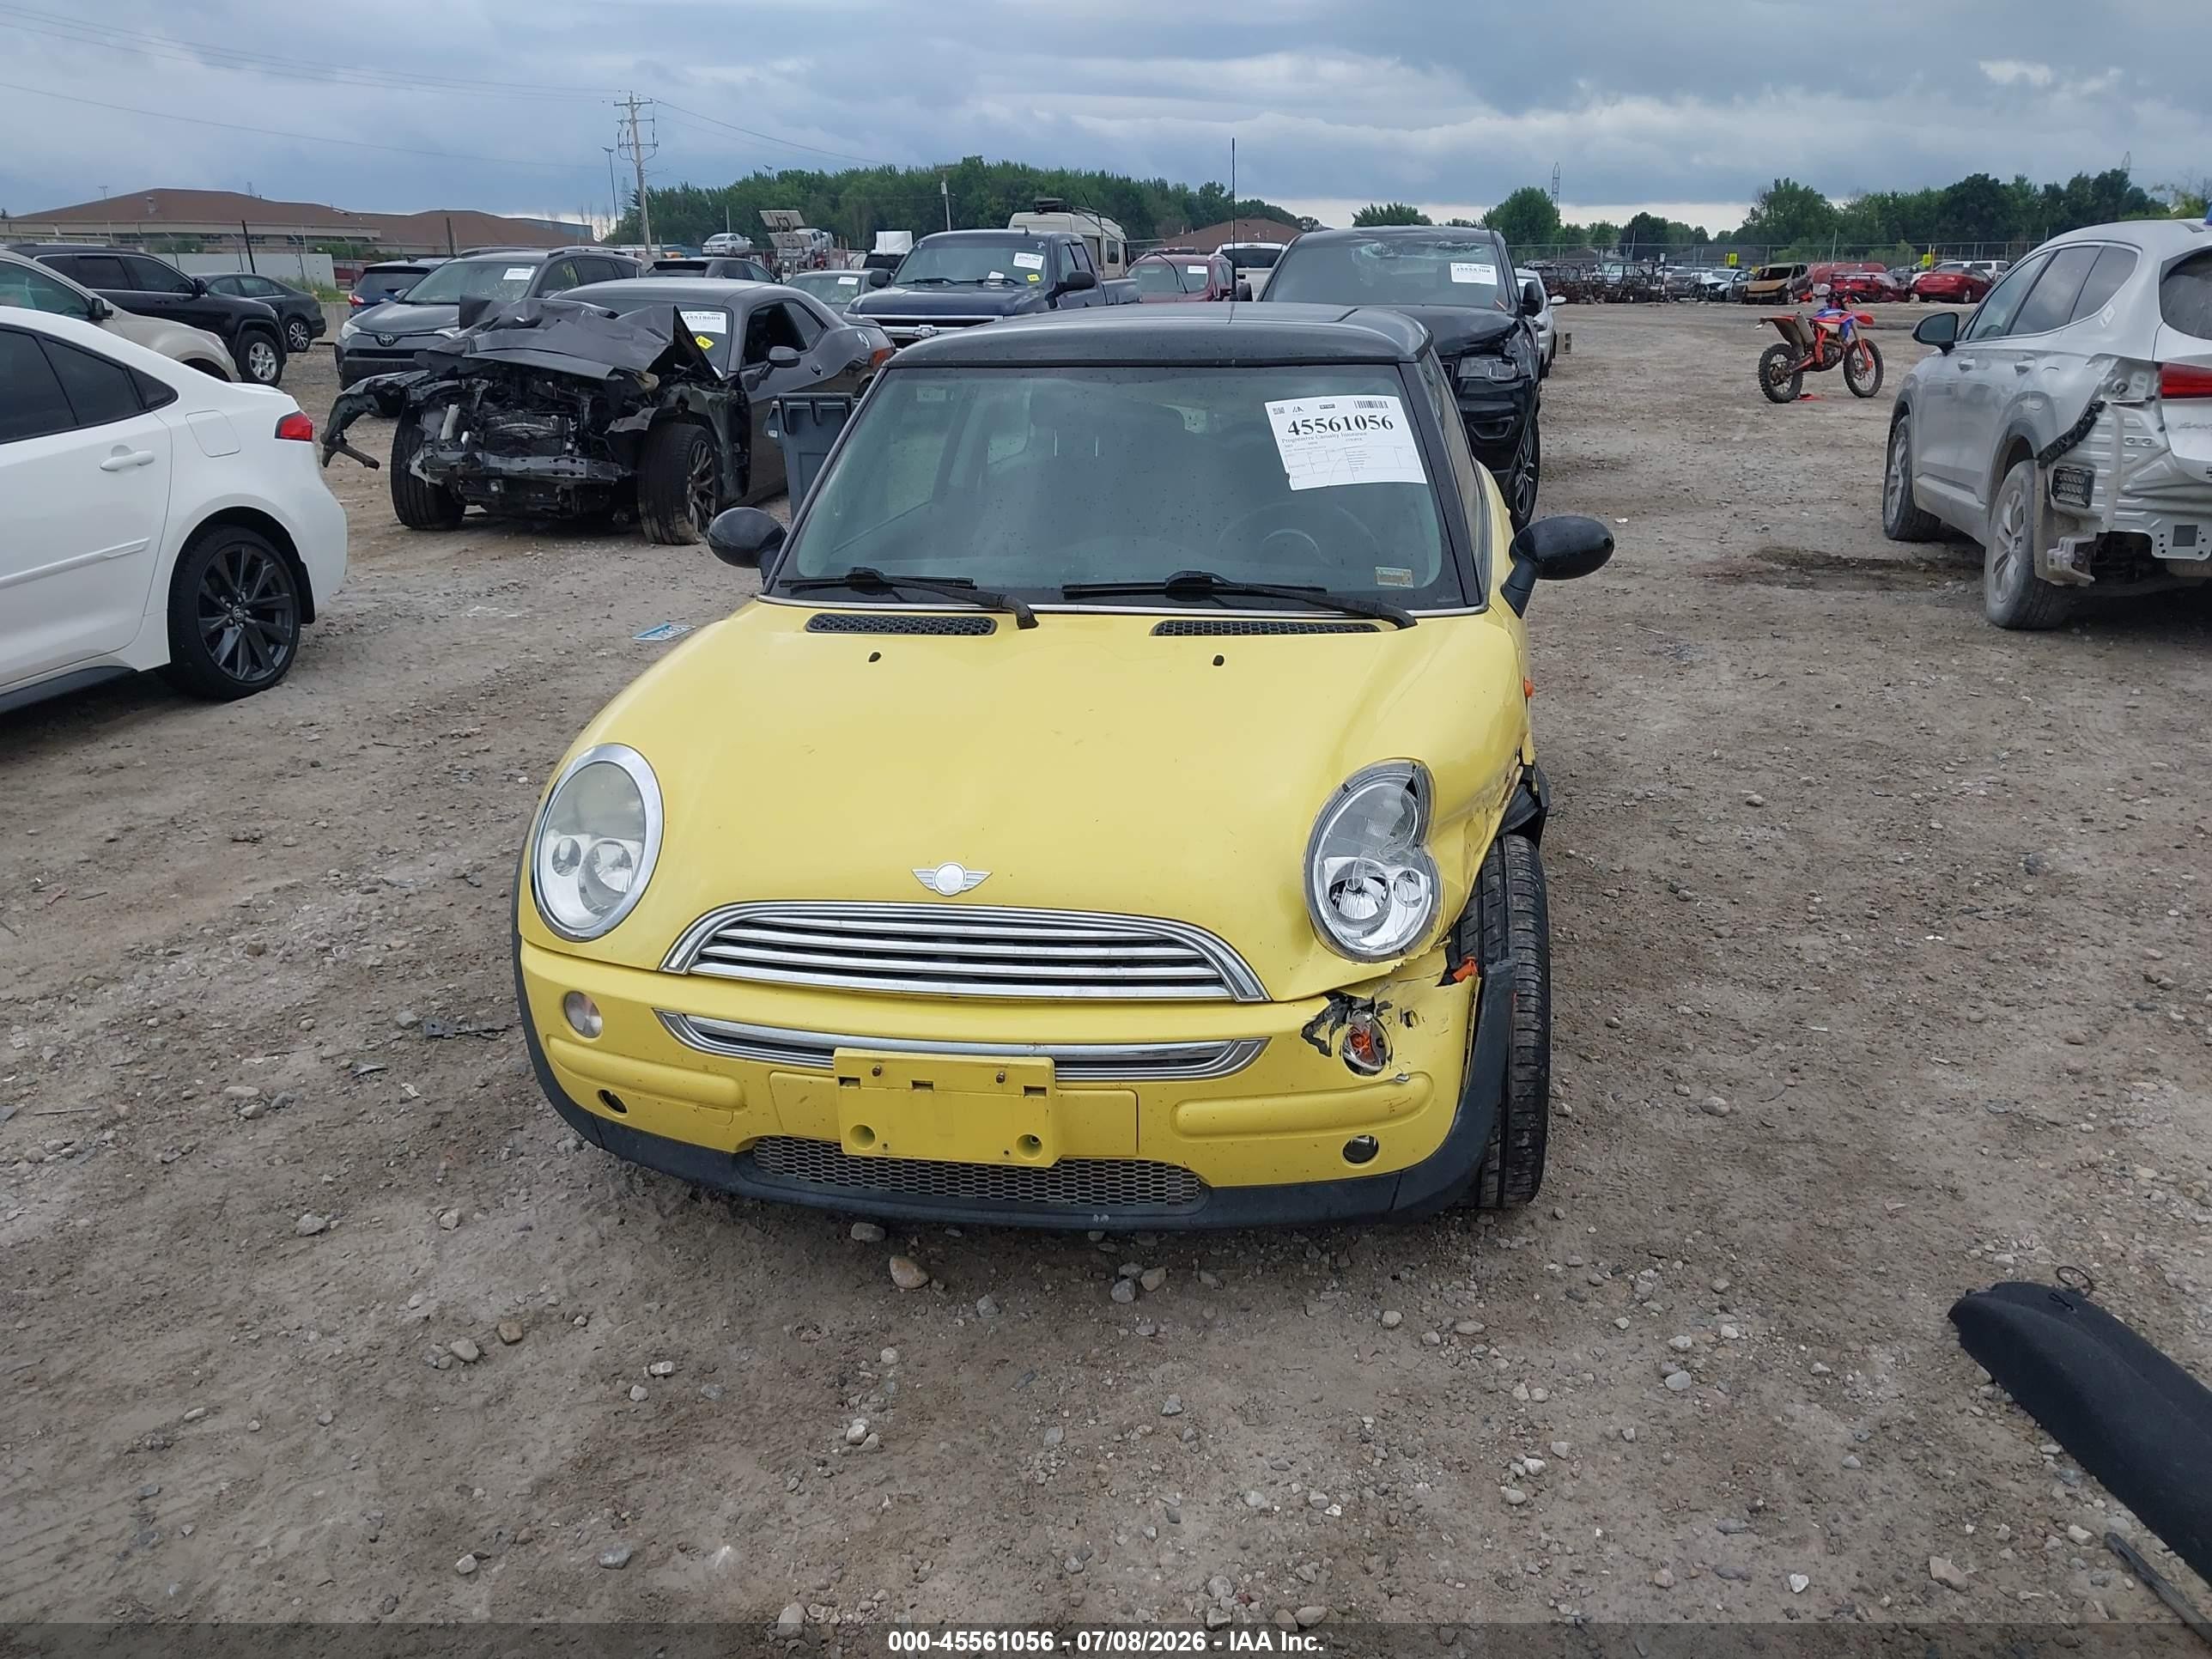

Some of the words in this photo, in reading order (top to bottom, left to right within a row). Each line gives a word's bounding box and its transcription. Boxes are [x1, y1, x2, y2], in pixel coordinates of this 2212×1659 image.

[1287, 414, 1395, 436] 45561056
[1281, 435, 1315, 445] Progressive
[1316, 433, 1340, 441] Casualty
